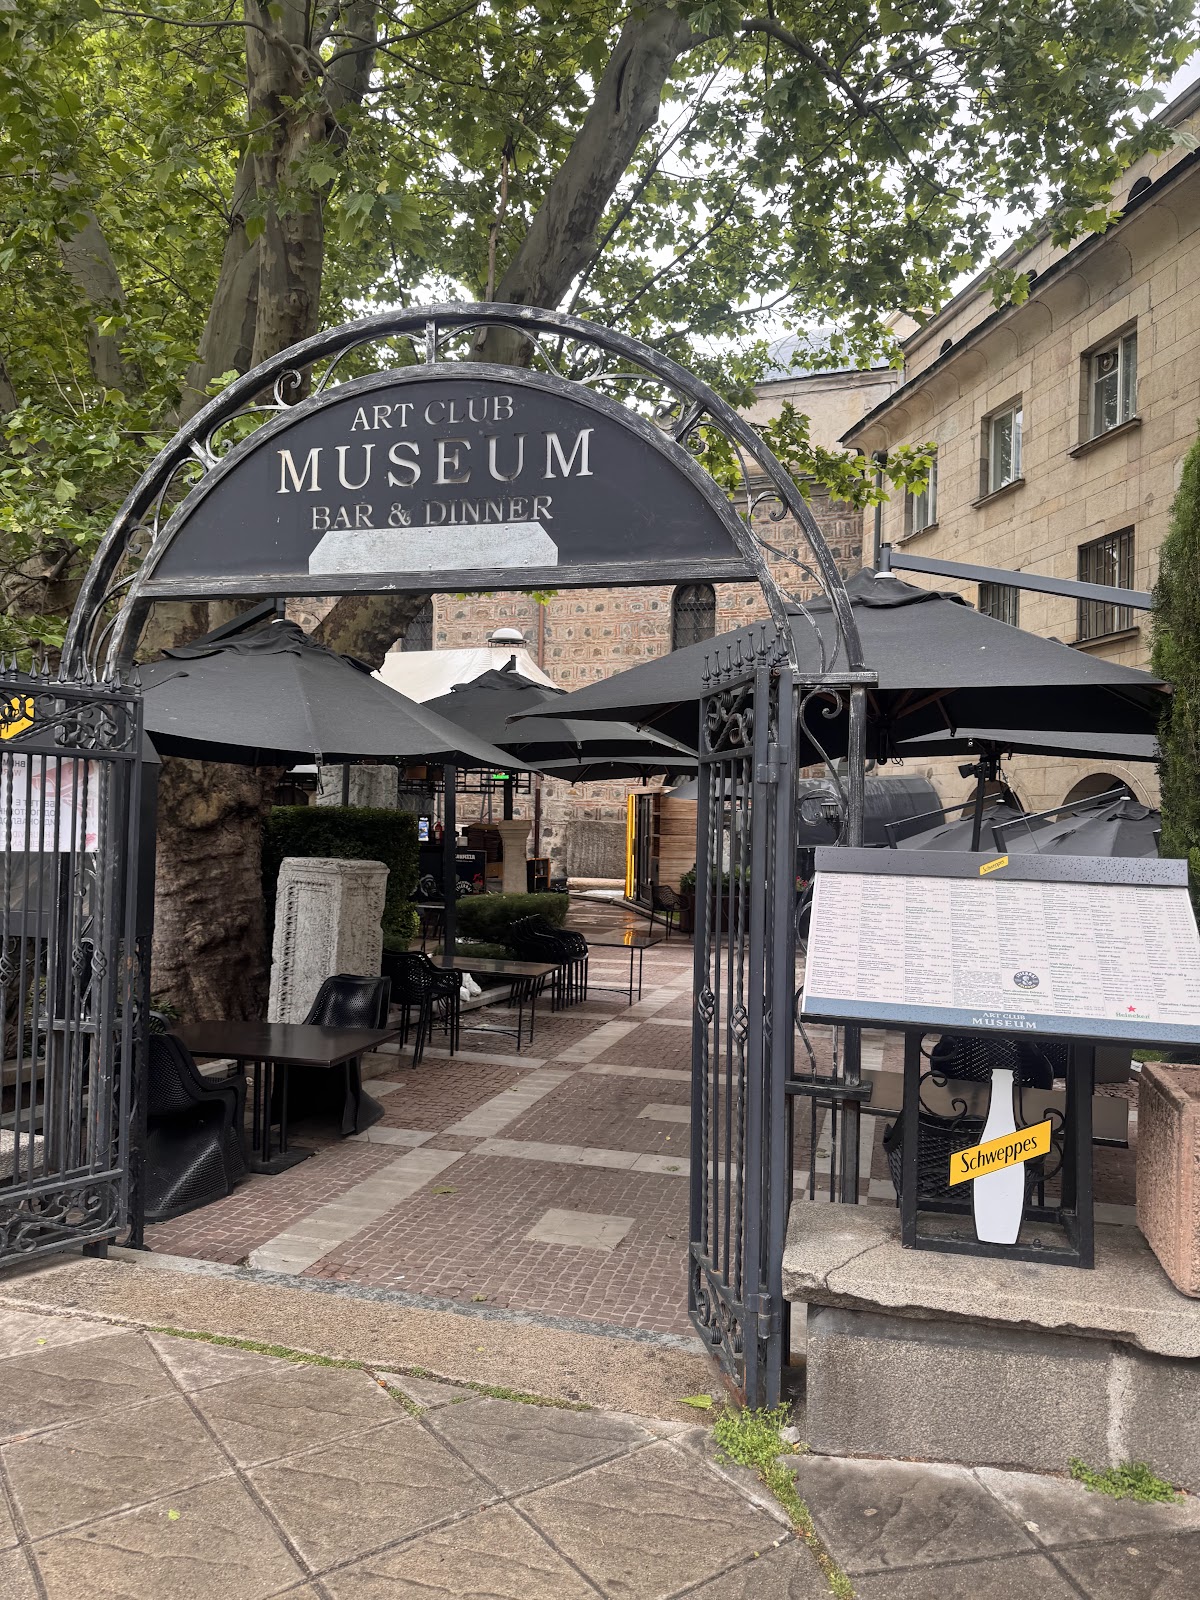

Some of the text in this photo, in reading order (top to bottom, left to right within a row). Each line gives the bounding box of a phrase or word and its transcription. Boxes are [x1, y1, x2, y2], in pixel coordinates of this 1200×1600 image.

[350, 395, 515, 432] ART CLUB
[276, 428, 595, 495] MUSEUM
[311, 495, 554, 531] BAR & DINNER
[972, 1017, 1037, 1029] MUSEUM
[1115, 1011, 1151, 1020] Heineken
[960, 1136, 1038, 1173] Schweppes
